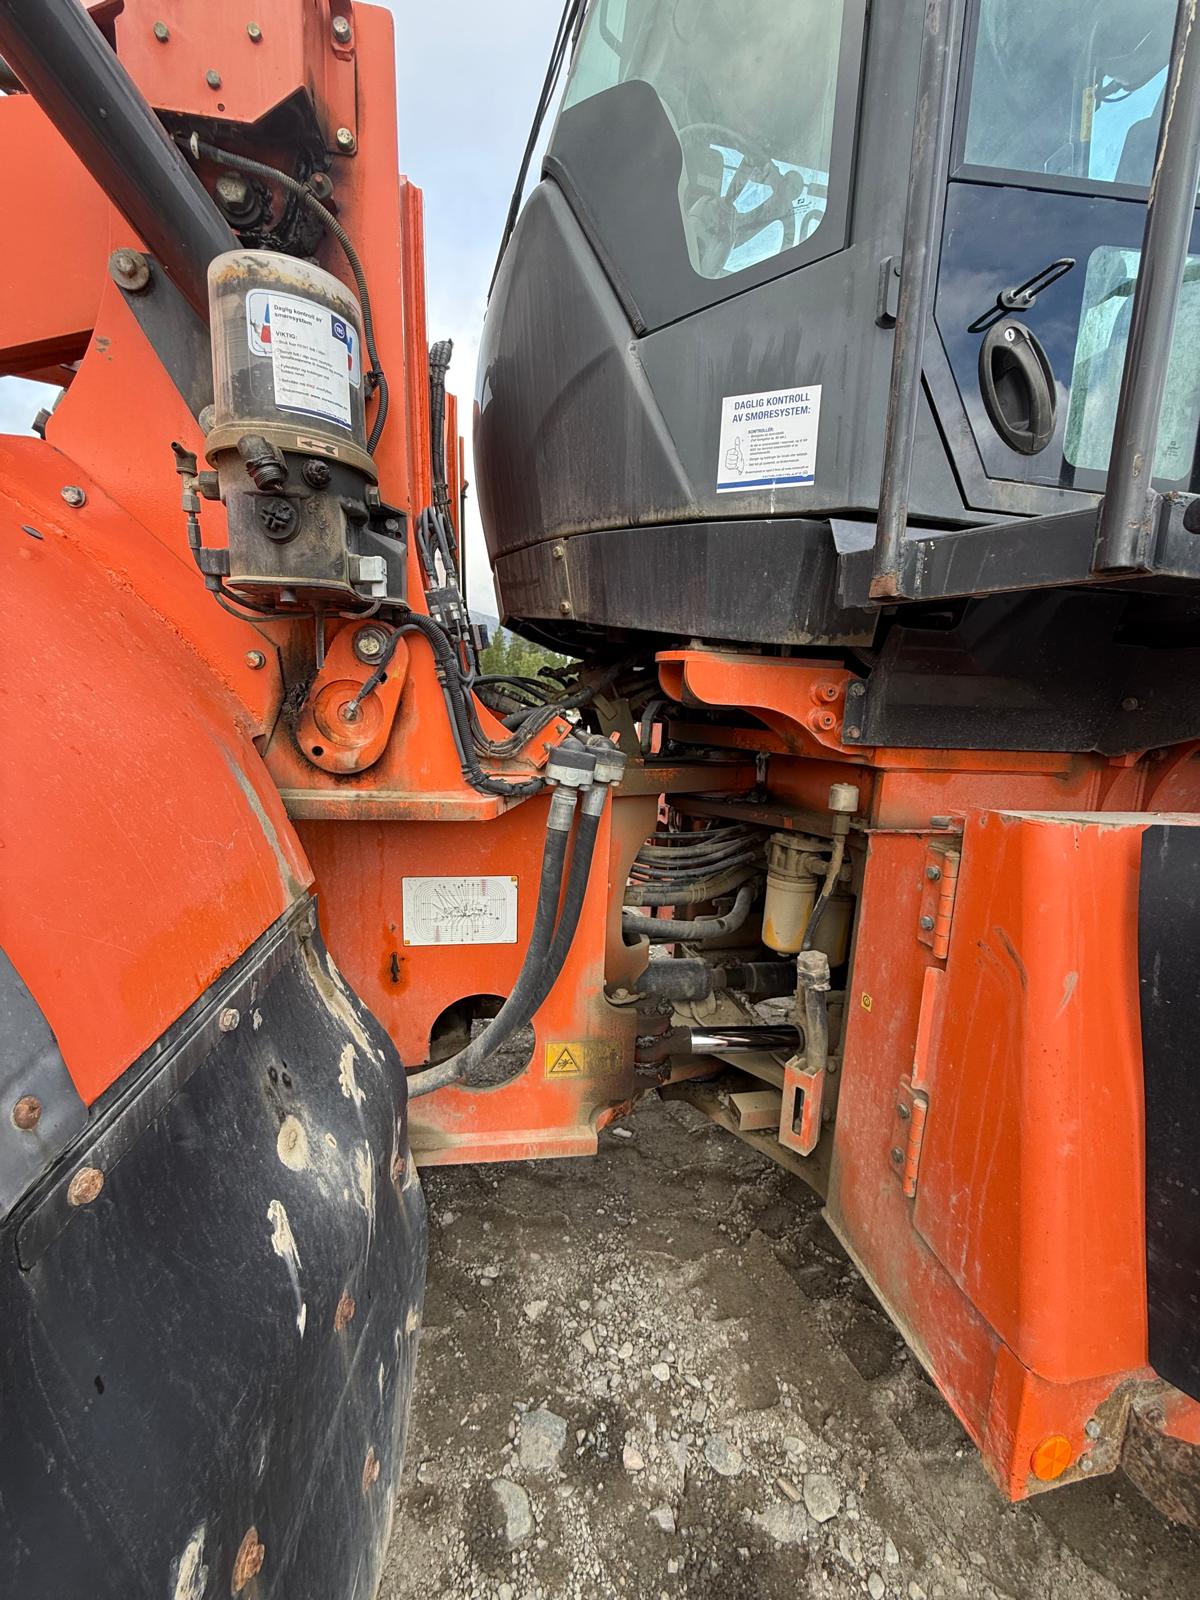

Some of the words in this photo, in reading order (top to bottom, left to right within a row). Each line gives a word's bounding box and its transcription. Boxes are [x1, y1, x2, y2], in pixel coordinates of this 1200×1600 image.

[273, 304, 293, 314] Daglig
[293, 307, 315, 320] kontroll
[734, 398, 764, 411] DAGLIG
[766, 392, 810, 406] KONTROLL
[732, 413, 743, 423] AV
[745, 405, 811, 421] SMØRESYSTEM:
